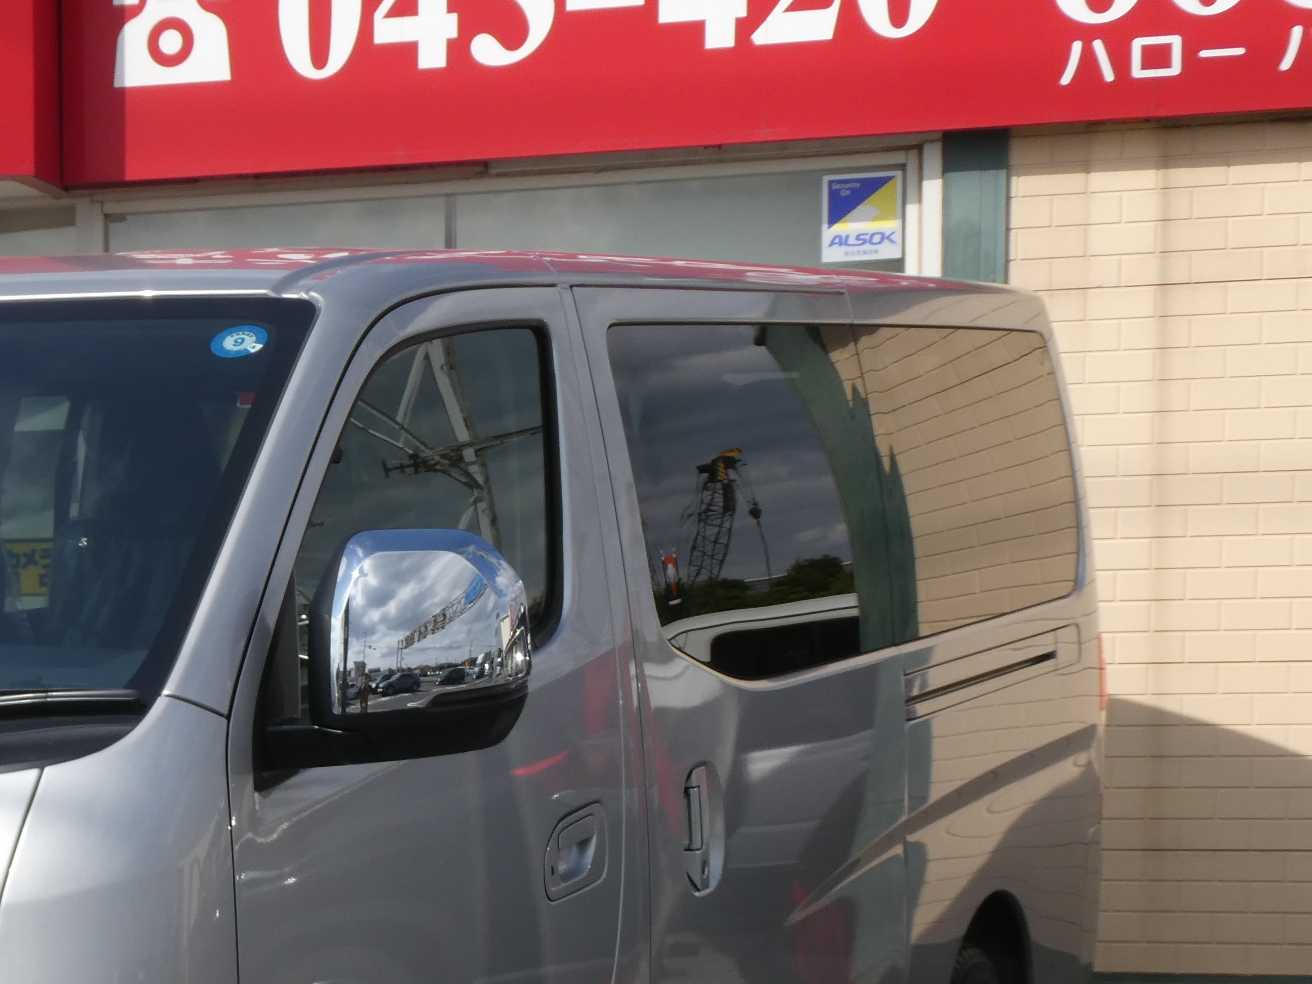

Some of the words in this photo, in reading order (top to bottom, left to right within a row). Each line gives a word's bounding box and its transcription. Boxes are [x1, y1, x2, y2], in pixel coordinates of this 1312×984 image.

[1059, 36, 1246, 85] ハロー
[828, 231, 897, 248] ALSOK
